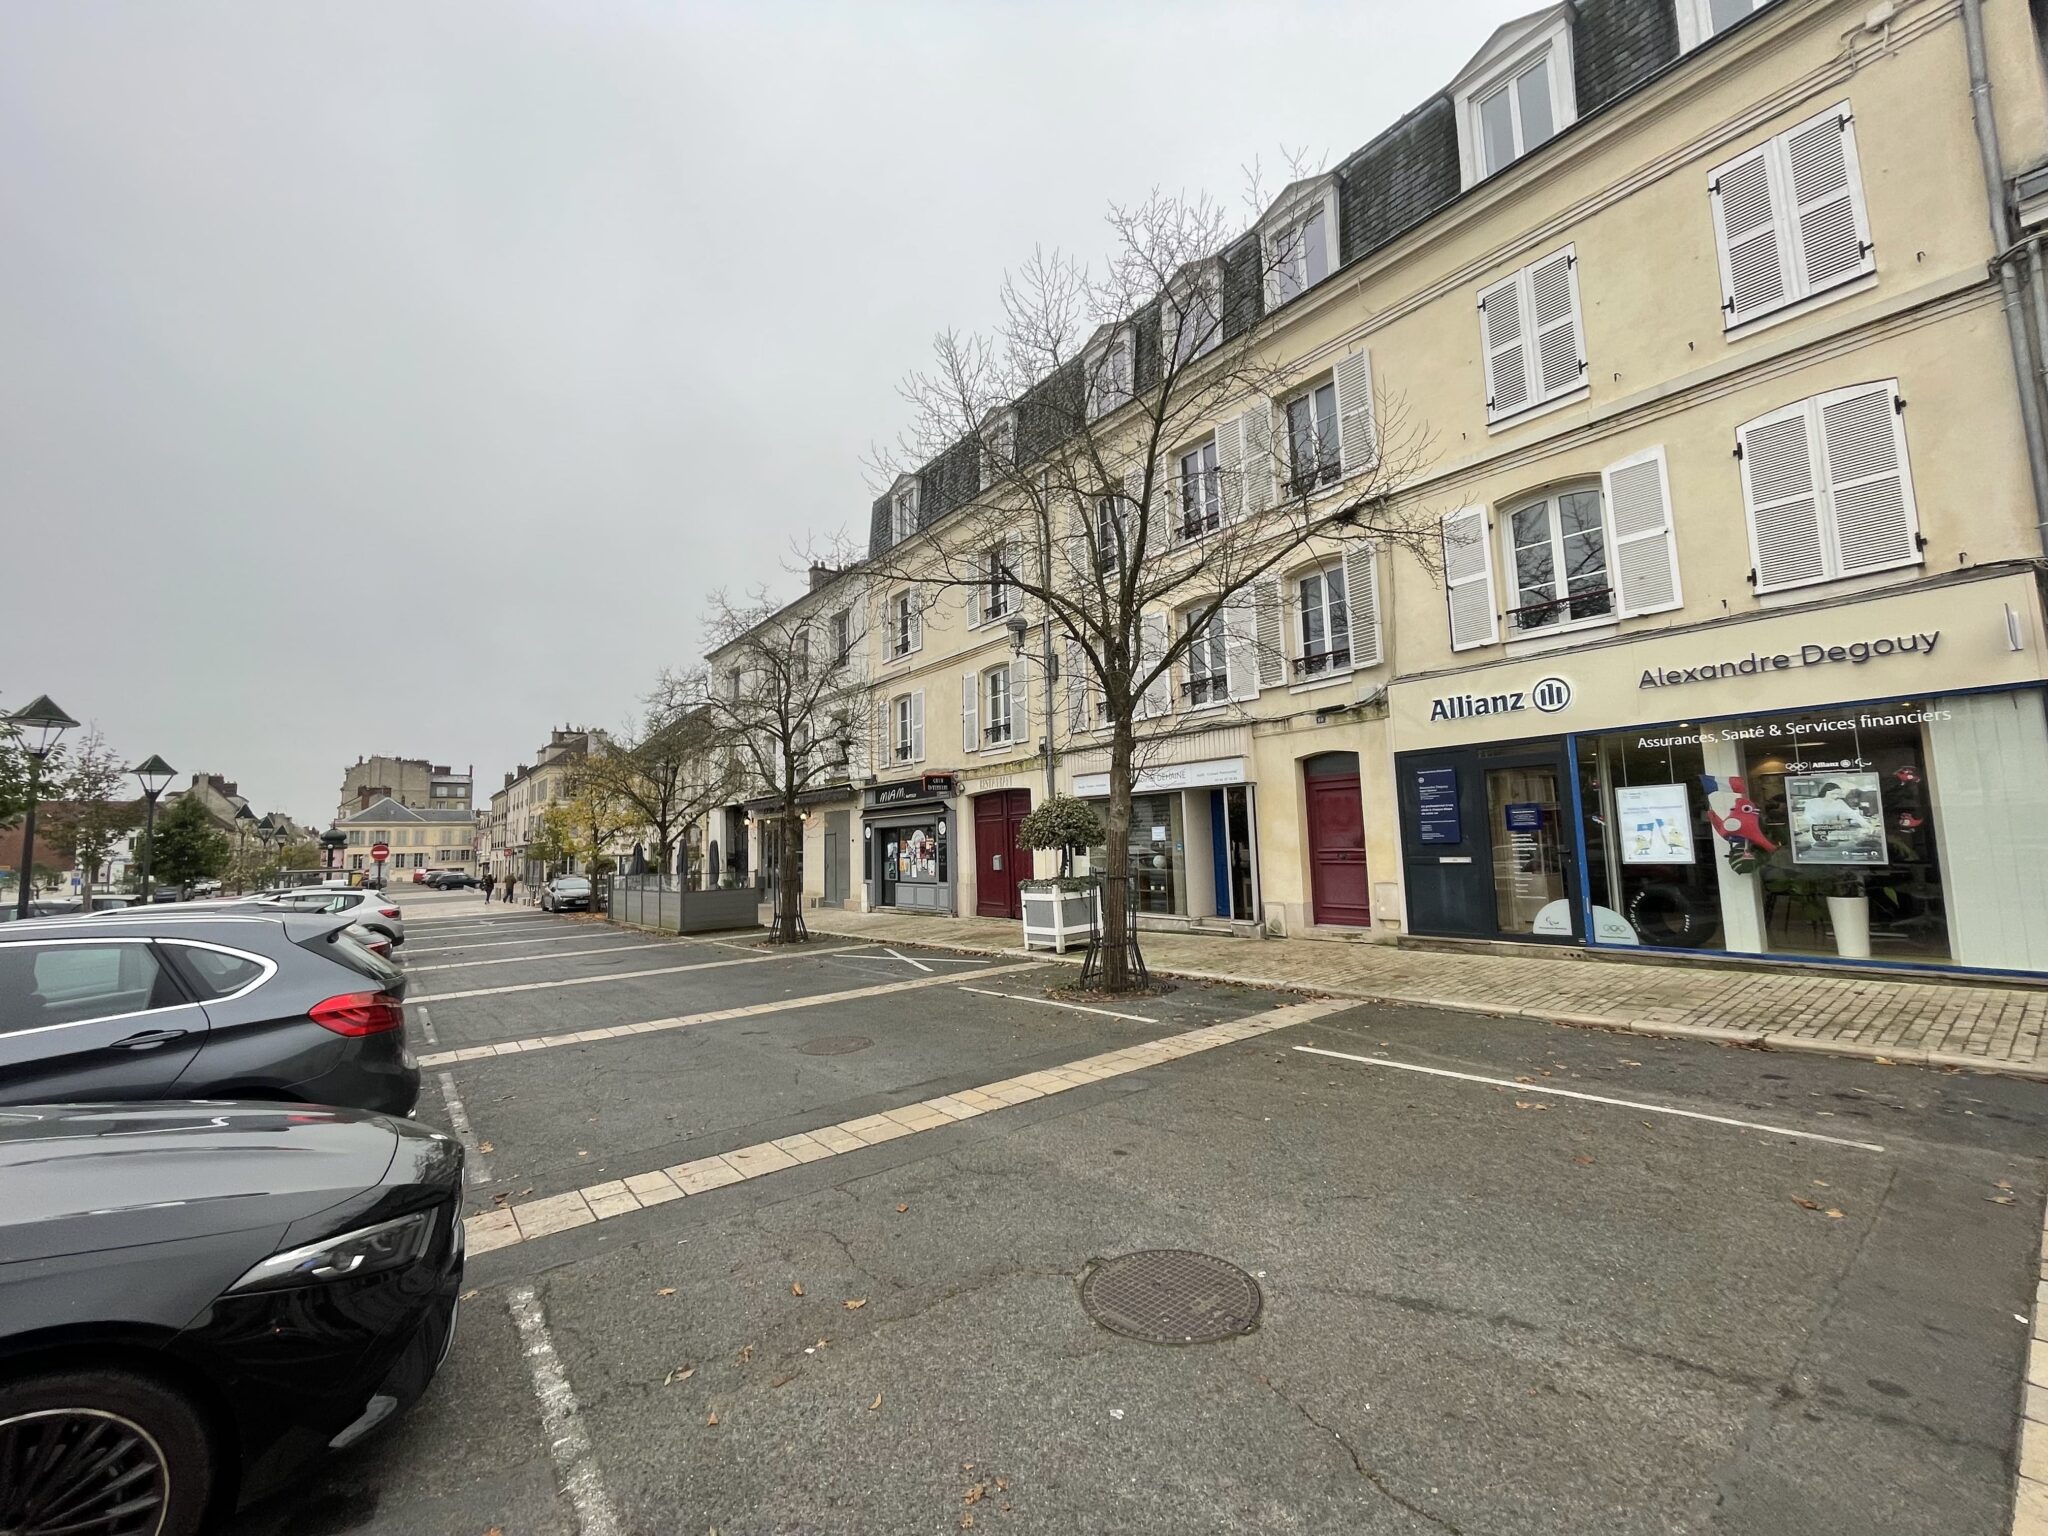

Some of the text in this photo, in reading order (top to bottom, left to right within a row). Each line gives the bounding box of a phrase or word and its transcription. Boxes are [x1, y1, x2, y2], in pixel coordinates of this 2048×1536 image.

[1639, 630, 1941, 689] Alexandre Degouy
[1430, 688, 1526, 722] Allianz
[1637, 708, 1952, 749] Assurances, Santé & Services financiers
